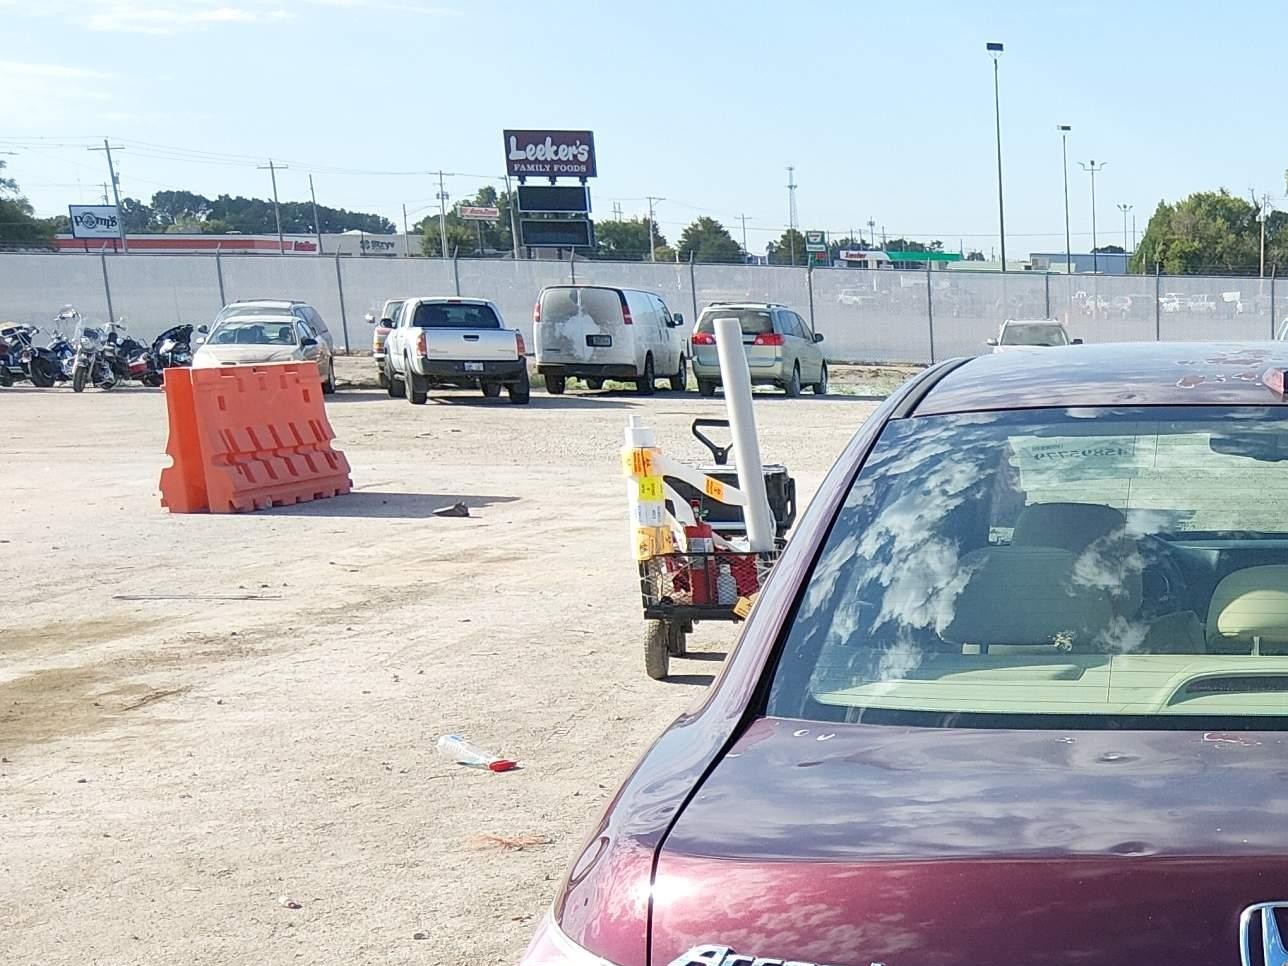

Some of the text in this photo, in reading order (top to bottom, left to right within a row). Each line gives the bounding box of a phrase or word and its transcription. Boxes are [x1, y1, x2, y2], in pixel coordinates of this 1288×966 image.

[509, 135, 590, 161] Leeker's
[513, 163, 587, 172] FAMILY FOODS
